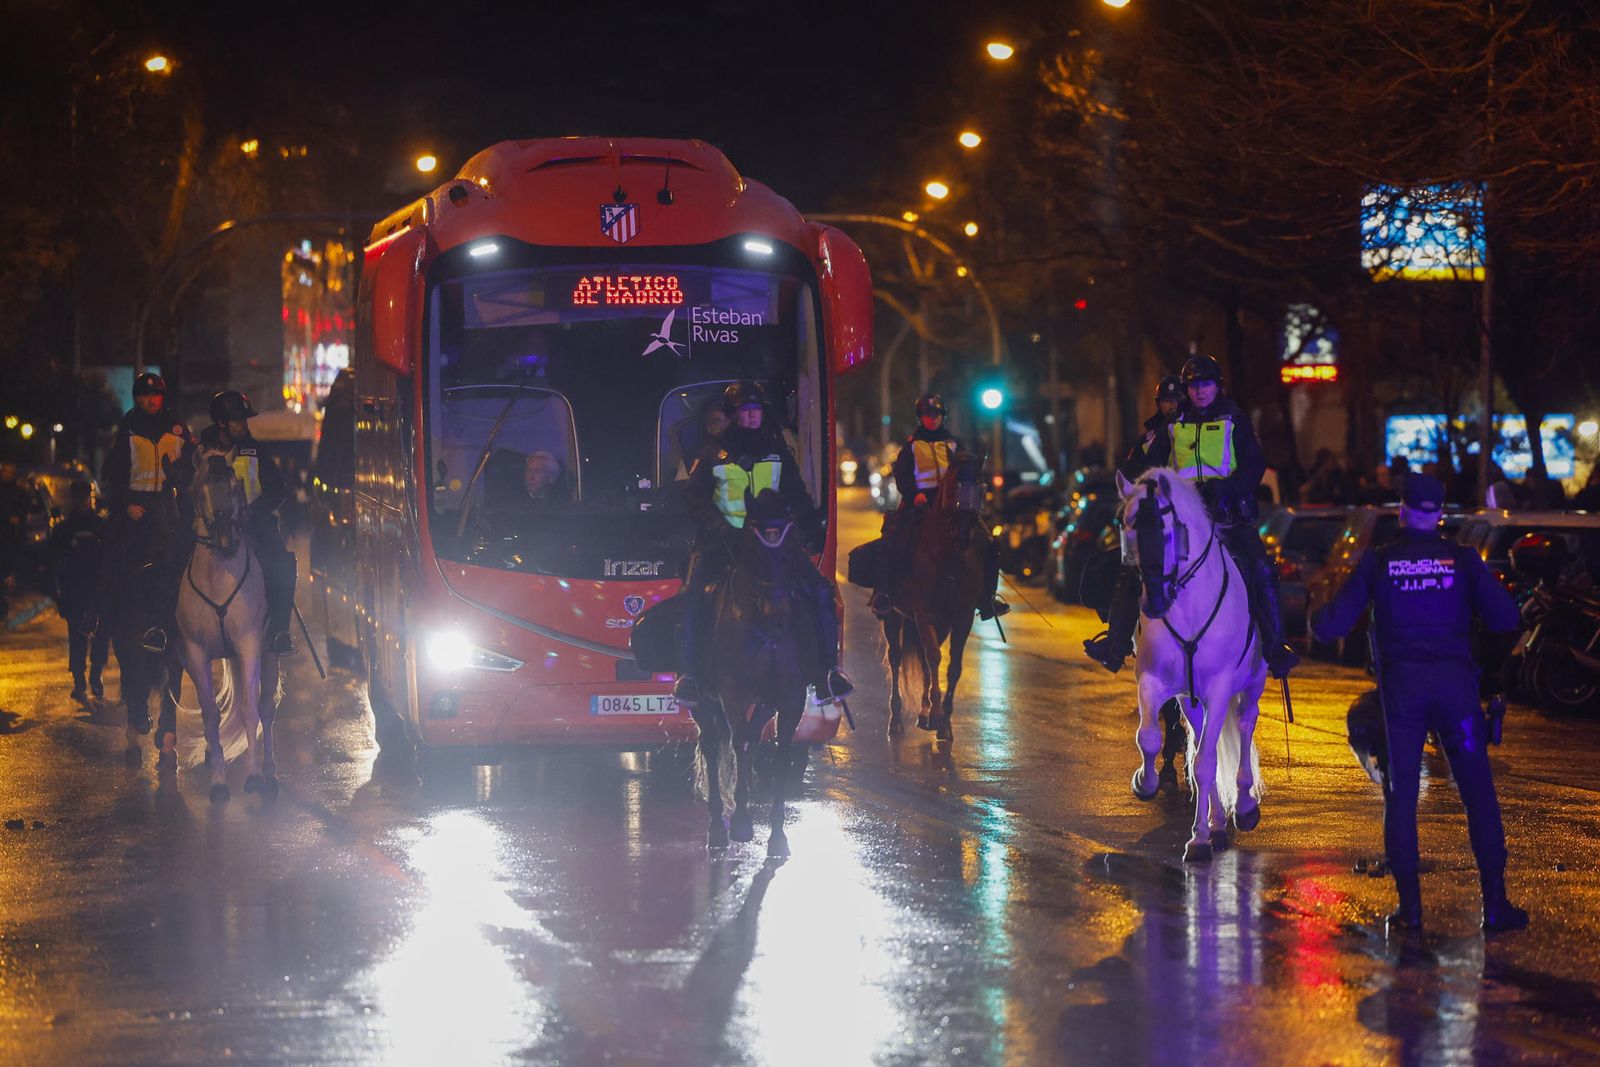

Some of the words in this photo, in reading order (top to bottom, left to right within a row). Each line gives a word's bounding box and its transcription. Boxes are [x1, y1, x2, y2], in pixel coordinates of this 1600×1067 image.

[578, 276, 679, 291] ATLETICO
[573, 290, 599, 305] DE
[606, 290, 684, 305] MADRID
[692, 307, 762, 326] Esteban
[693, 325, 739, 343] Rivas
[604, 559, 664, 576] Irizar
[1389, 565, 1455, 576] NACIONAL
[602, 697, 641, 712] 0845
